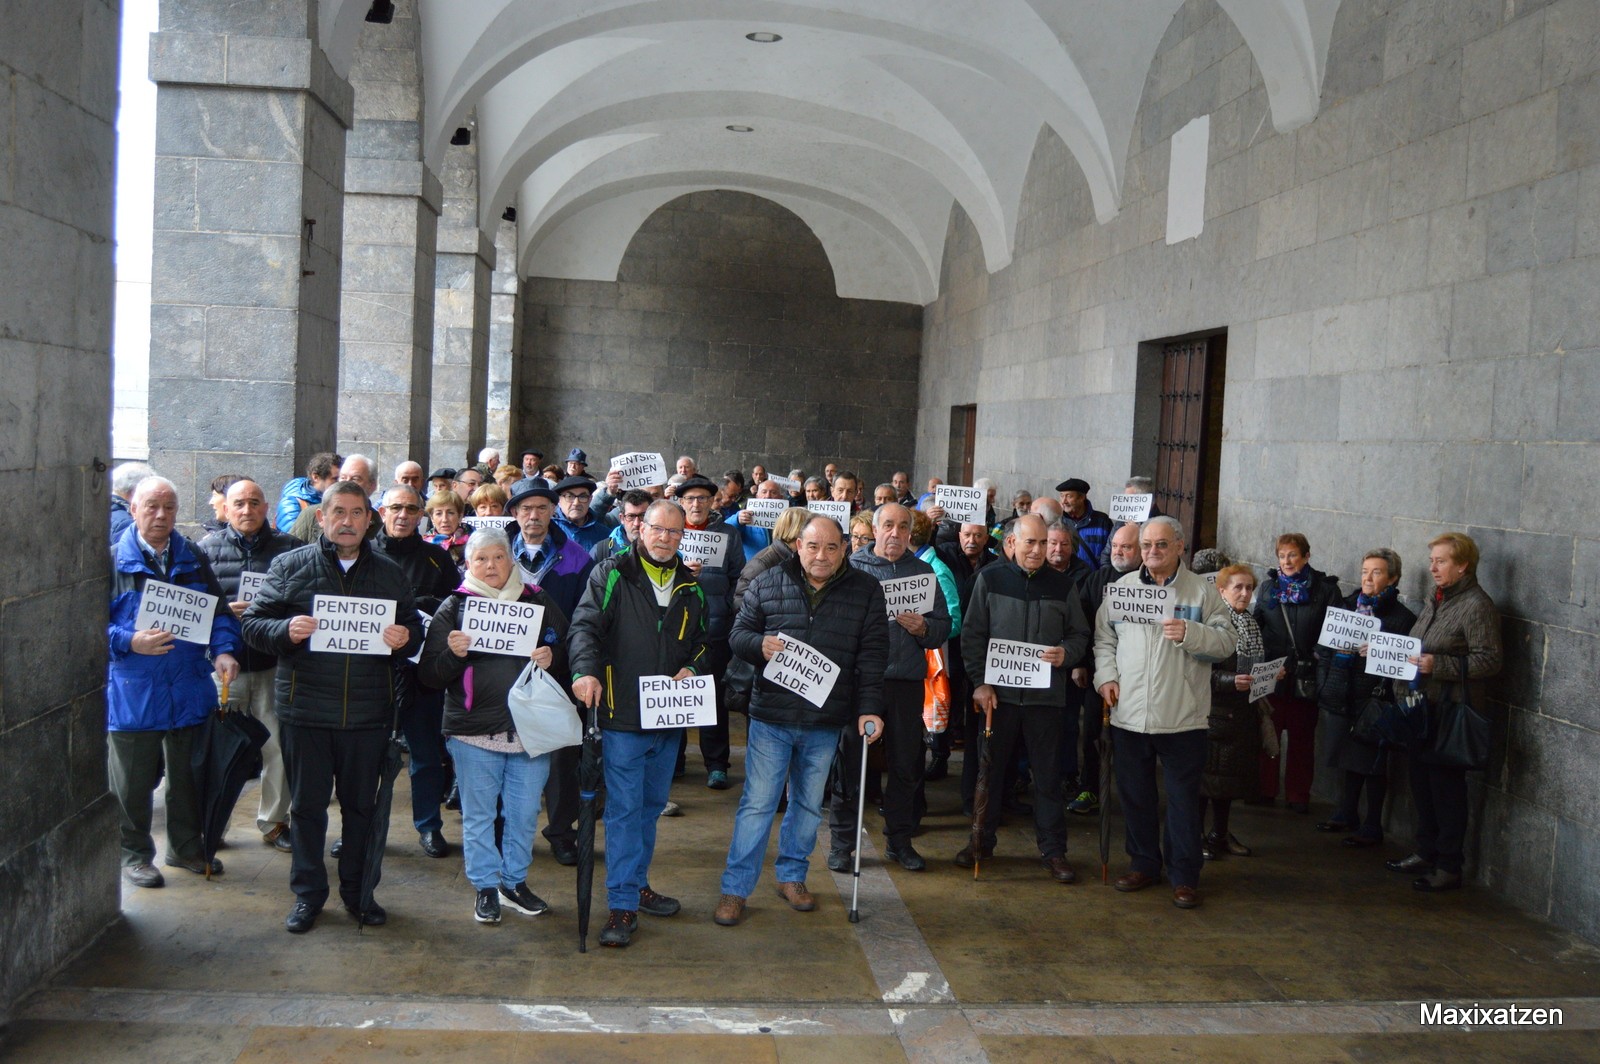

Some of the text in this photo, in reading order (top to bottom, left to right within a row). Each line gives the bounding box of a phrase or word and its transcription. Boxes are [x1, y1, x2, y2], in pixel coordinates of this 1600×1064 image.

[613, 454, 656, 466] PENTSIO
[626, 476, 653, 488] ALDE
[937, 488, 981, 500] PENTSIO
[748, 501, 784, 509] PENTSIO
[809, 504, 846, 512] PENTSIO
[938, 500, 978, 511] DUINEN
[754, 519, 775, 528] ALDE
[944, 512, 971, 522] ALDE
[682, 532, 722, 543] ENTSIO
[884, 578, 930, 594] ENTSIO
[1110, 586, 1168, 600] PENTSIO
[146, 584, 209, 609] PENTSIO
[145, 601, 202, 624] DUINEN
[316, 600, 387, 616] PENTSIO
[468, 600, 534, 618] PENTSIO
[1112, 601, 1164, 615] DUINEN
[318, 618, 381, 634] DUINEN
[1122, 614, 1156, 625] ALDE
[1327, 610, 1375, 629] PENTSIO
[468, 618, 528, 636] DUINEN
[1326, 624, 1369, 641] DUINEN
[326, 638, 370, 650] ALDE
[474, 637, 516, 651] ALDE
[1328, 638, 1359, 651] ALDE
[1370, 634, 1415, 650] PENTSIO
[775, 652, 824, 686] DUINEN
[991, 658, 1040, 673] DUINEN
[1375, 664, 1404, 677] ALDE
[773, 671, 810, 696] ALDE
[997, 674, 1032, 686] ALDE
[646, 695, 704, 709] DUINEN
[656, 713, 696, 726] ALDE
